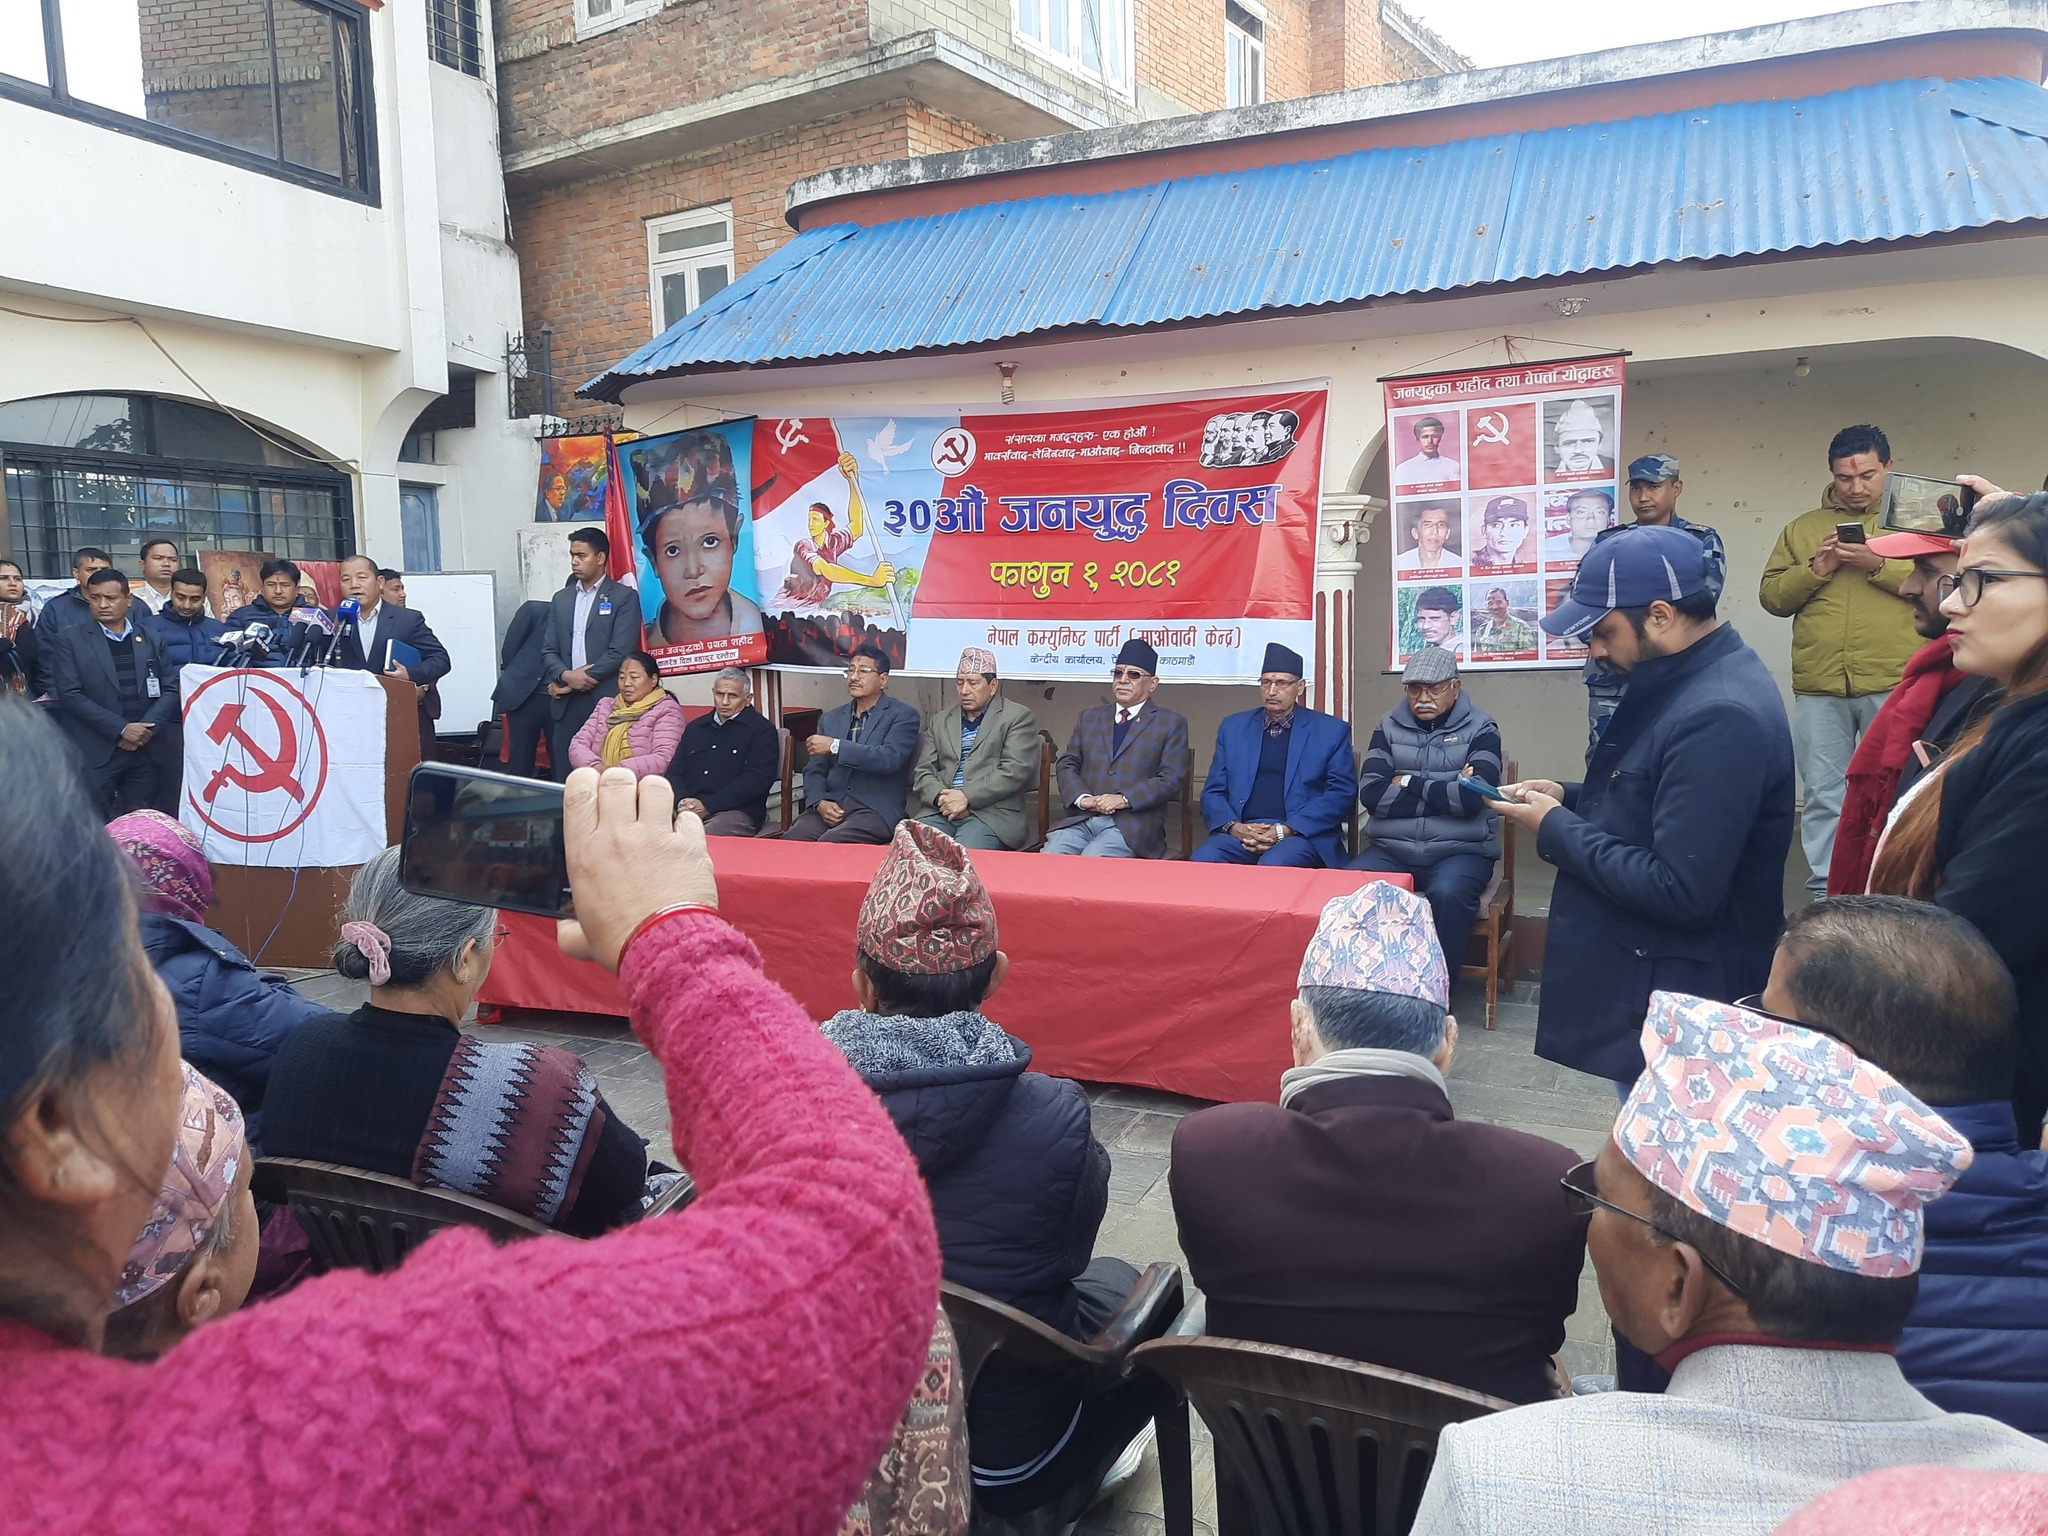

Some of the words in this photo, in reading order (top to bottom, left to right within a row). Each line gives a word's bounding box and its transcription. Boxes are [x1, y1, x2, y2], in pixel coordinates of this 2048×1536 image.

[1455, 376, 1491, 394] शहीद
[1495, 375, 1520, 389] तथा
[1102, 429, 1120, 441] एक
[999, 493, 1152, 543] जनयुद्ध
[1163, 478, 1284, 531] दिवस
[989, 560, 1075, 600] फागुन
[1109, 559, 1181, 589] २०८१
[707, 639, 728, 651] प्रथम
[730, 635, 754, 647] शहीद
[987, 625, 1020, 647] नेपाल
[1026, 625, 1088, 652] कम्युनिष्ट
[1094, 624, 1121, 648] पार्टी
